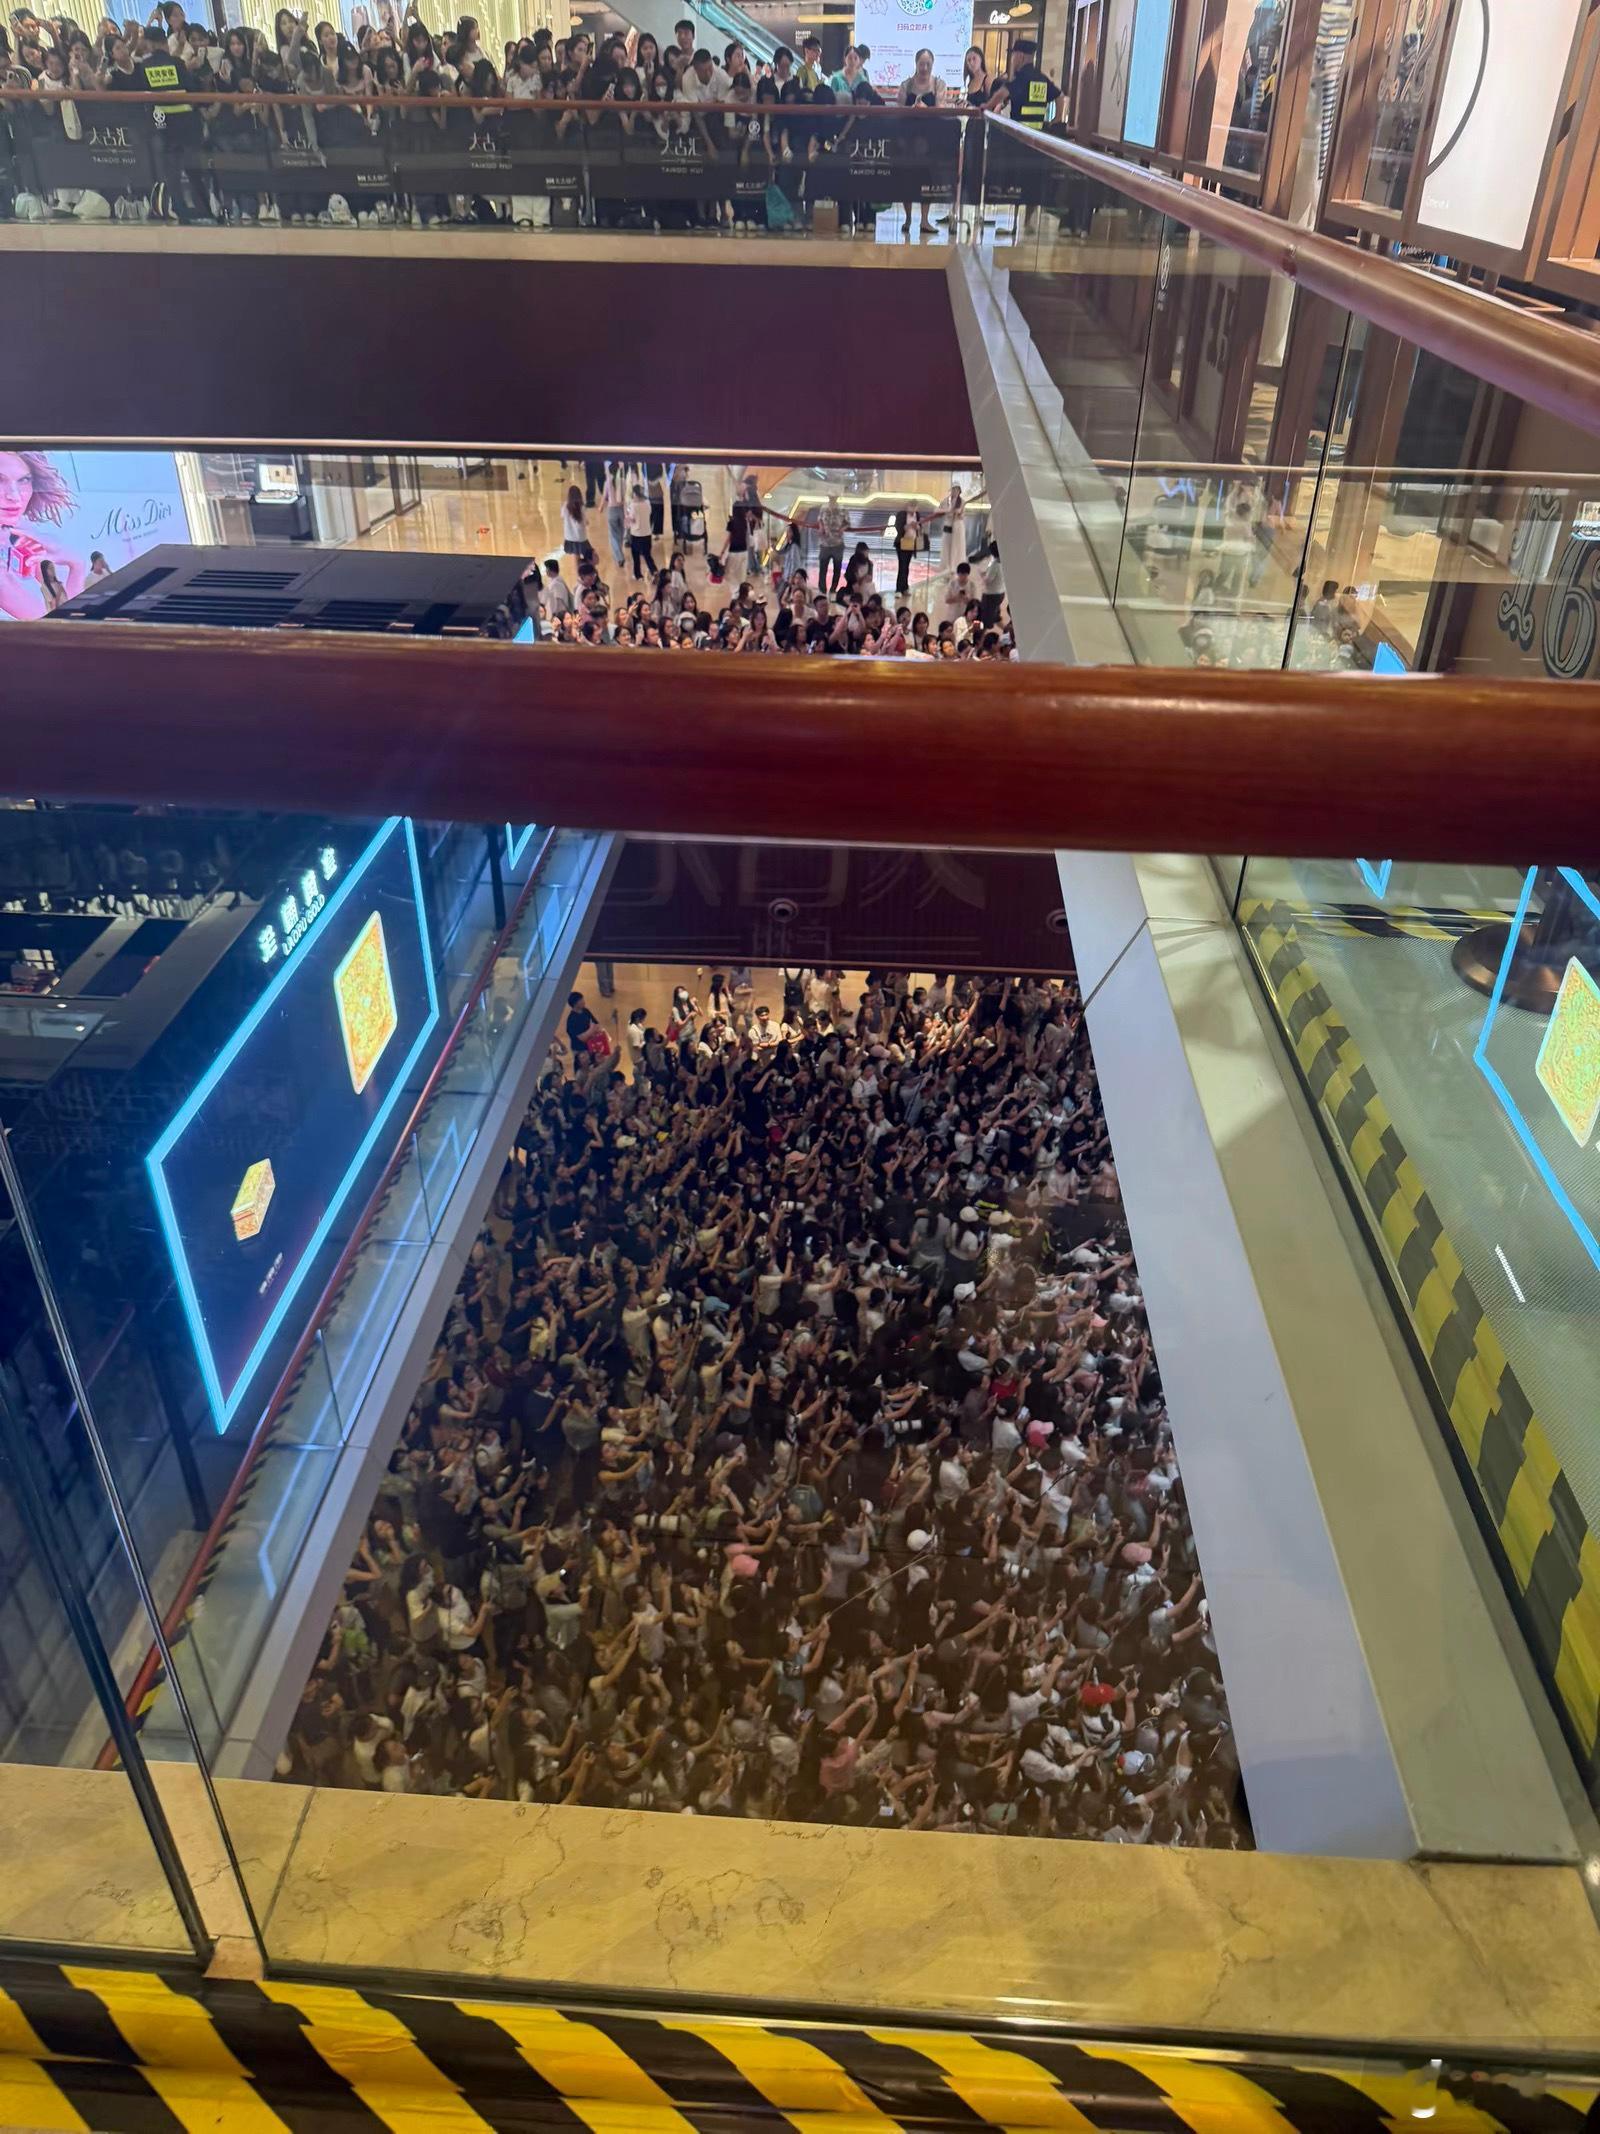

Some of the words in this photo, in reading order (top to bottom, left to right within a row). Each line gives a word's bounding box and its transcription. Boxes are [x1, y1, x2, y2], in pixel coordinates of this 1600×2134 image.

[91, 507, 141, 539] Miss
[144, 499, 172, 525] Dior
[283, 917, 307, 955] LAOPU
[305, 894, 325, 923] GOLD
